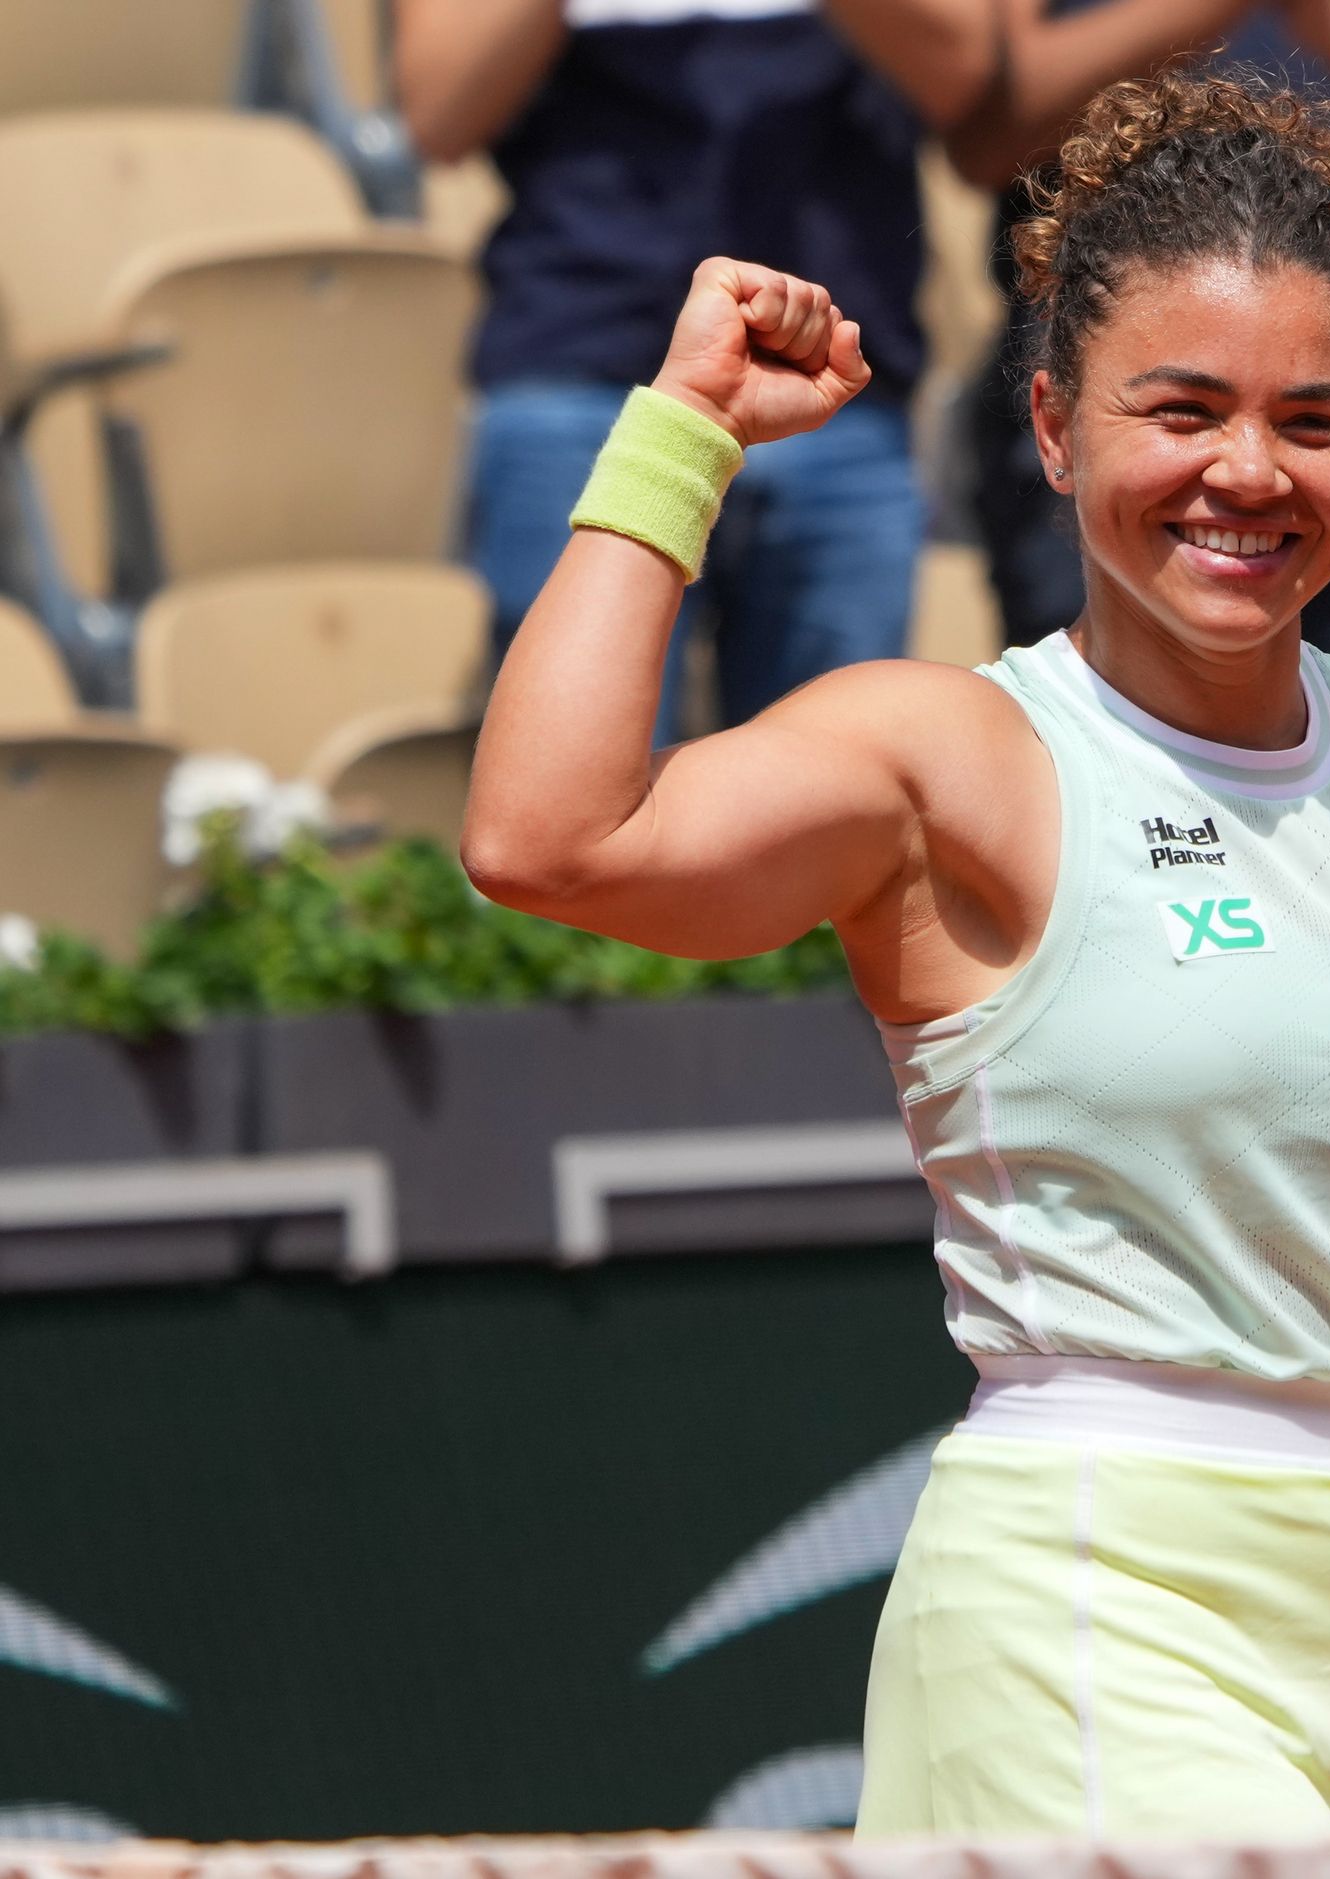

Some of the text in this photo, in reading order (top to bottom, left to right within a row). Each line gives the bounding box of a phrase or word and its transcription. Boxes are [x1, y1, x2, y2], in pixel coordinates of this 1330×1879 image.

[1140, 816, 1220, 846] Hotel
[1150, 846, 1226, 869] Planner
[1167, 898, 1265, 955] XS
